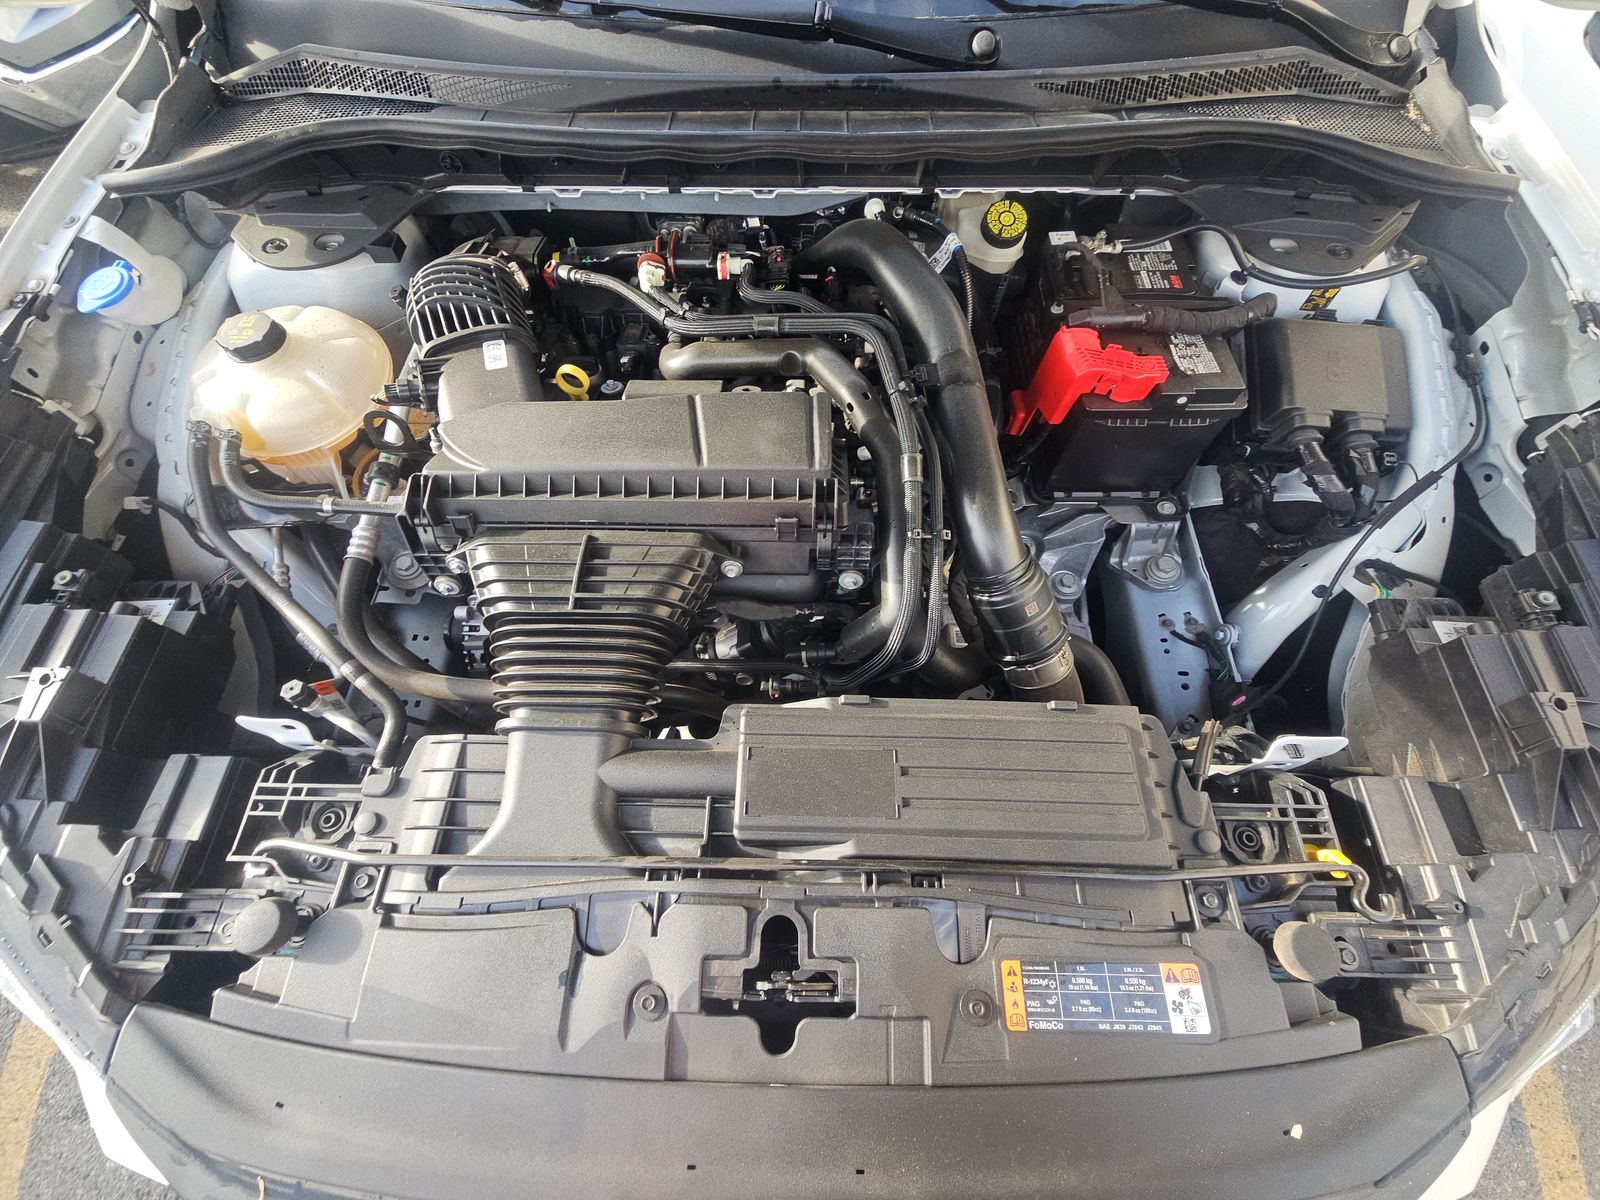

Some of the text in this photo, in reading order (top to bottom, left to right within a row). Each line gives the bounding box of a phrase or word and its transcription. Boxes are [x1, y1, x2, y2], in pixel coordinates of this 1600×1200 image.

[1023, 978, 1048, 986] R-1234yf
[1139, 978, 1146, 986] kg
[1029, 1021, 1064, 1030] FoMoCo
